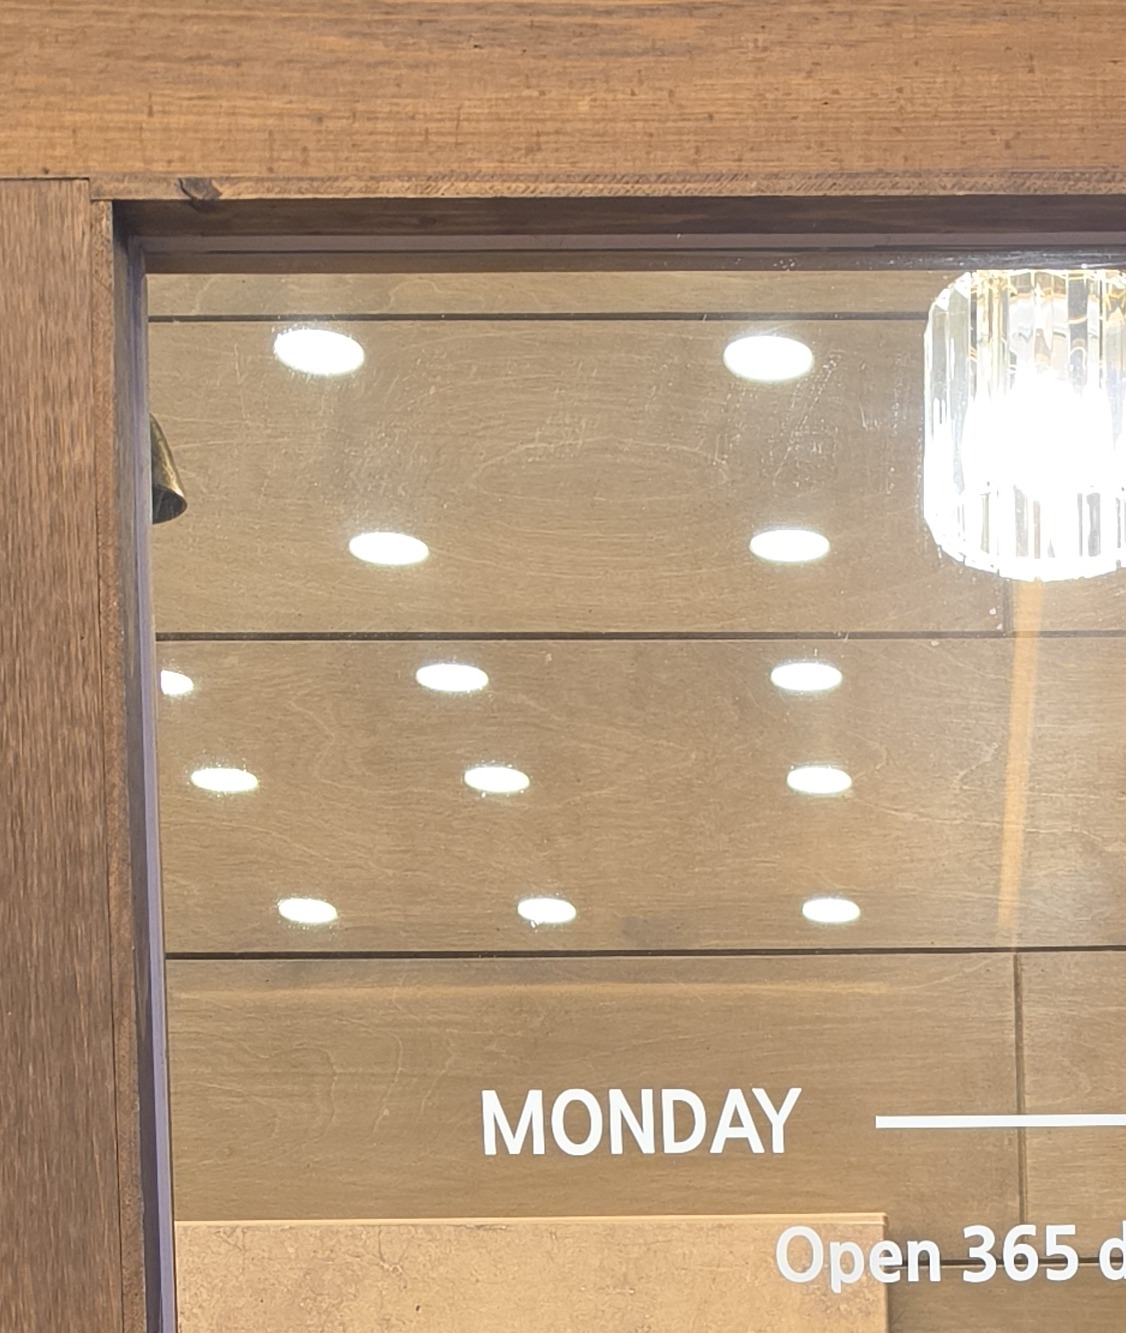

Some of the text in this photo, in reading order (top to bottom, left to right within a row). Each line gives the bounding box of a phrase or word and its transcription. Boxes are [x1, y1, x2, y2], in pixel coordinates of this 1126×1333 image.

[482, 1088, 802, 1155] MONDAY
[775, 1225, 941, 1293] Open
[963, 1224, 1078, 1282] 365
